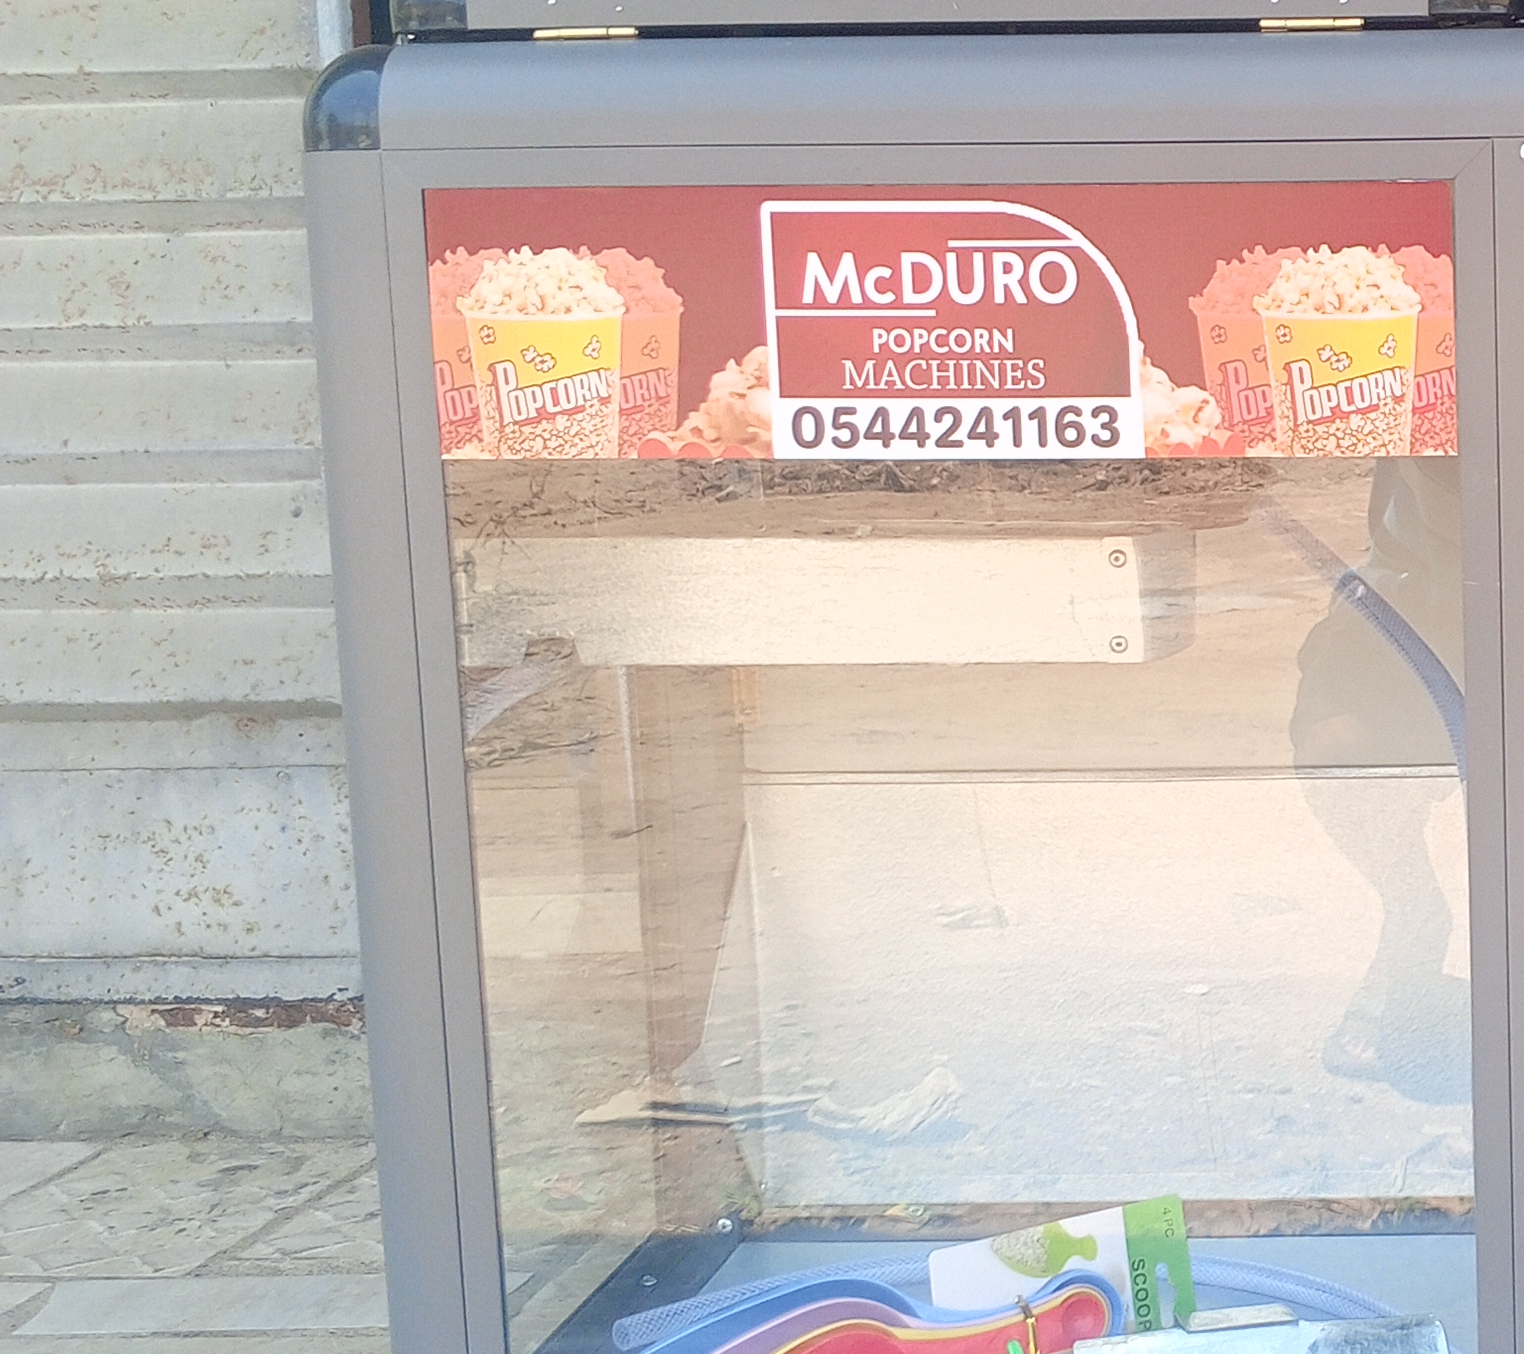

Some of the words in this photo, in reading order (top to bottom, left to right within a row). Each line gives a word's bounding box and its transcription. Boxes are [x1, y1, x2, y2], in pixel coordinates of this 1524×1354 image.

[802, 250, 1079, 306] McDURO
[871, 328, 1015, 354] POPCORN
[841, 359, 1047, 391] MACHINES
[792, 405, 1121, 449] 0544241163
